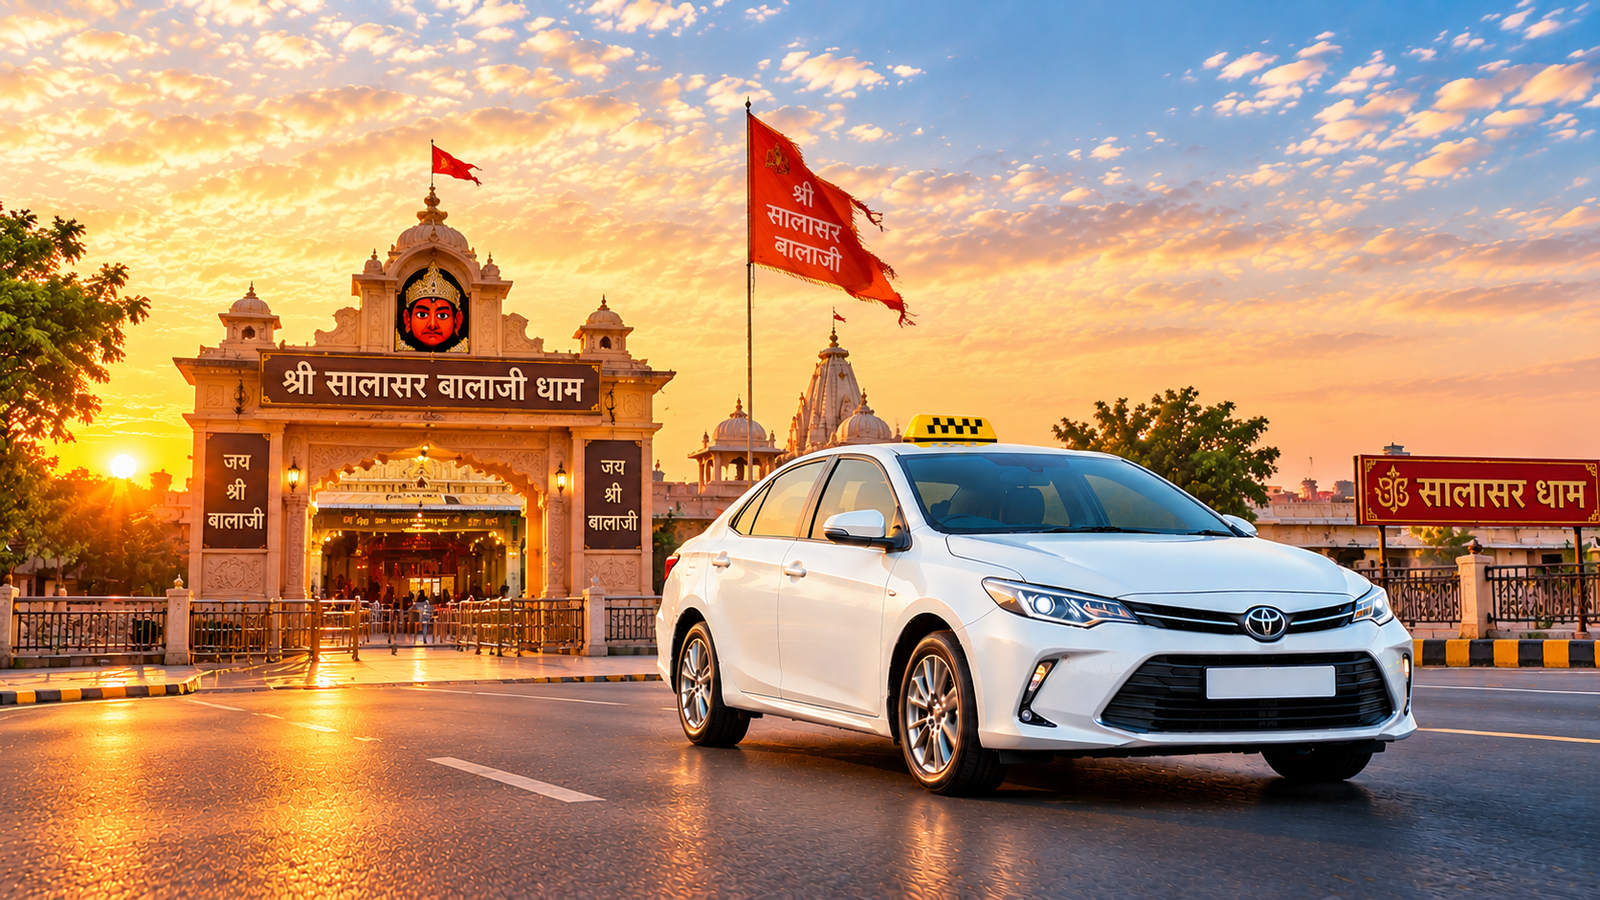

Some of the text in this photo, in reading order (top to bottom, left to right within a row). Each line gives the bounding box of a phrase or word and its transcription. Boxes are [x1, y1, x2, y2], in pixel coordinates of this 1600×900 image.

[793, 181, 814, 208] श्री
[766, 203, 842, 244] सालासर
[775, 235, 843, 273] बालाजी
[282, 360, 585, 402] श्री सालासर बालाजी धाम
[223, 454, 252, 472] जय
[601, 459, 626, 476] जय
[226, 478, 246, 501] श्री
[604, 482, 623, 504] श्री
[1416, 478, 1587, 509] सालासर धाम
[207, 507, 264, 530] बालाजी
[588, 509, 638, 532] बालाजी
